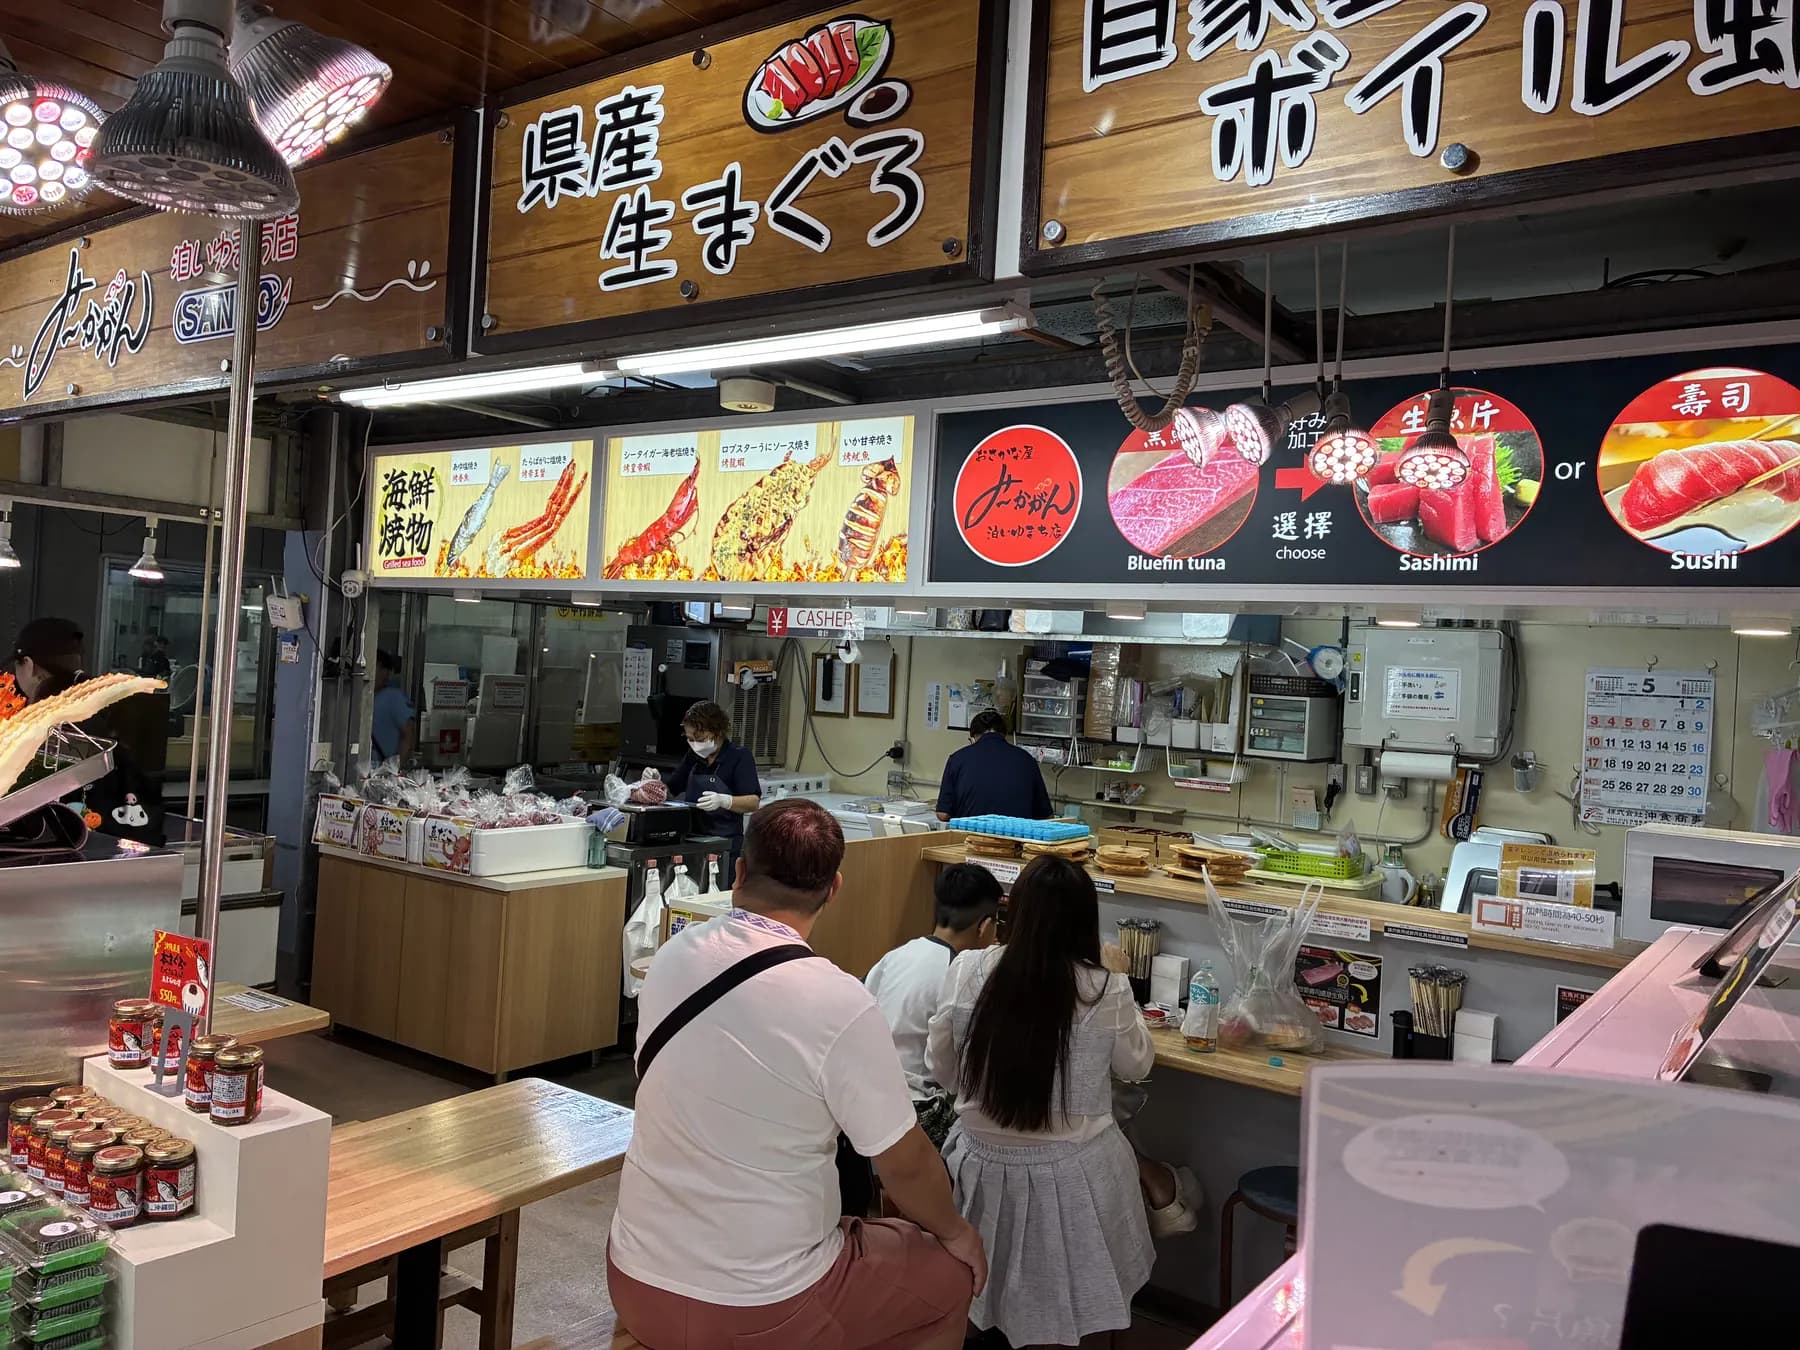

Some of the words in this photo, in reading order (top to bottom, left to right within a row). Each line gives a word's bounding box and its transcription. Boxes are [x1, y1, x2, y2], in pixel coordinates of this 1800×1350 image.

[518, 85, 665, 213] 県産
[599, 129, 924, 291] 生まぐろ
[179, 282, 276, 338] SANO
[722, 439, 810, 453] ロブスターうにソース焼き
[844, 435, 893, 447] いか甘辛焼き
[1554, 461, 1585, 480] or
[382, 466, 435, 511] 海鮮
[378, 513, 433, 558] 焼物
[1275, 545, 1326, 560] choose
[1671, 551, 1738, 570] Sushi
[383, 558, 401, 569] Grilled
[402, 559, 410, 567] sea
[411, 557, 425, 567] food
[1127, 555, 1184, 571] Bluefin
[1187, 557, 1226, 571] tuna
[1399, 554, 1479, 572] Sashimi
[1642, 678, 1655, 693] 5
[1679, 700, 1685, 708] 1
[1695, 700, 1704, 709] 2
[1591, 716, 1599, 725] 3
[1607, 717, 1616, 726] 4
[1625, 718, 1633, 727] 5
[1642, 719, 1650, 728] 6
[1659, 719, 1667, 729] 7
[1677, 720, 1686, 730] 8
[1695, 721, 1703, 731] 9
[1589, 736, 1600, 746] 10
[1605, 738, 1616, 747] 11
[1622, 739, 1634, 748] 12
[1639, 740, 1651, 749] 13
[1656, 741, 1669, 750] 14
[1674, 742, 1687, 752] 15
[1692, 743, 1704, 753] 16
[1587, 758, 1599, 767] 17
[1604, 759, 1616, 768] 18
[1621, 760, 1633, 770] 19
[1637, 761, 1651, 771] 20
[1655, 762, 1667, 772] 21
[1672, 763, 1686, 773] 22
[1689, 765, 1703, 774] 23
[1602, 780, 1616, 790] 25
[1619, 781, 1633, 791] 26
[1636, 782, 1649, 792] 27
[1653, 784, 1667, 794] 28
[1671, 785, 1684, 795] 29
[1688, 786, 1701, 796] 30
